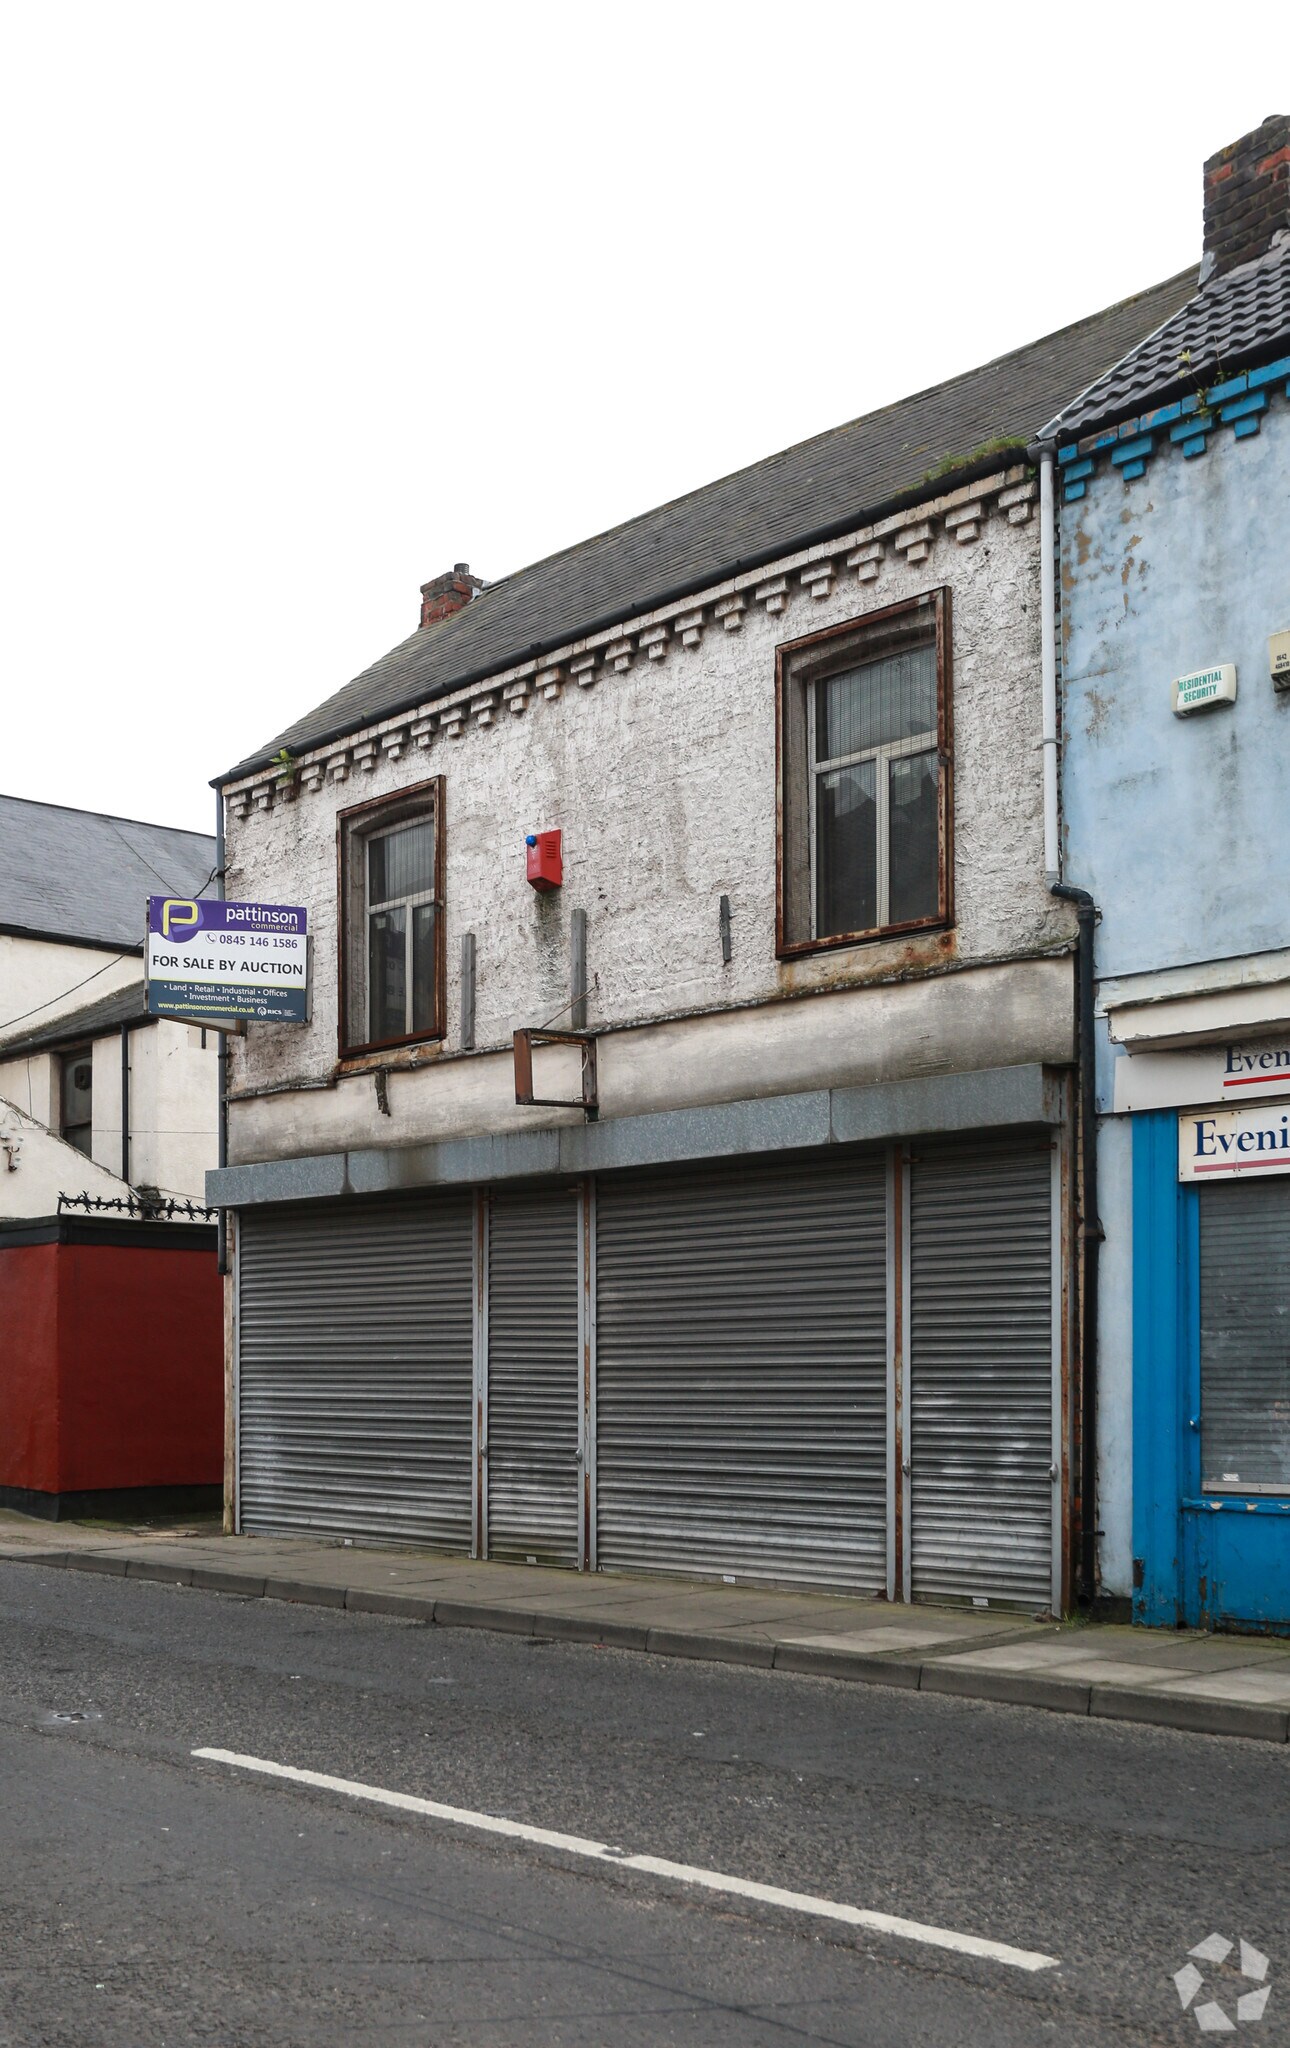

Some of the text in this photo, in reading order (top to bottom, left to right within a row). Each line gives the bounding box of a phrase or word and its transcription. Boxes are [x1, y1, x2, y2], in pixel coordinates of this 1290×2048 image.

[1179, 670, 1222, 692] RESIDENTIAL
[1184, 684, 1217, 703] SECURITY
[226, 907, 298, 924] pattinson
[251, 923, 298, 932] commercial
[219, 934, 298, 949] 0845 146 1586
[153, 955, 303, 975] FOR SALE BY AUCTION
[169, 983, 288, 998] Land Retail Industrial Offices
[189, 993, 268, 1004] Investment Business
[158, 1002, 255, 1013] www.pattinsoncommercial.co.uk
[1224, 1045, 1290, 1074] Even
[1193, 1116, 1290, 1157] Eveni
